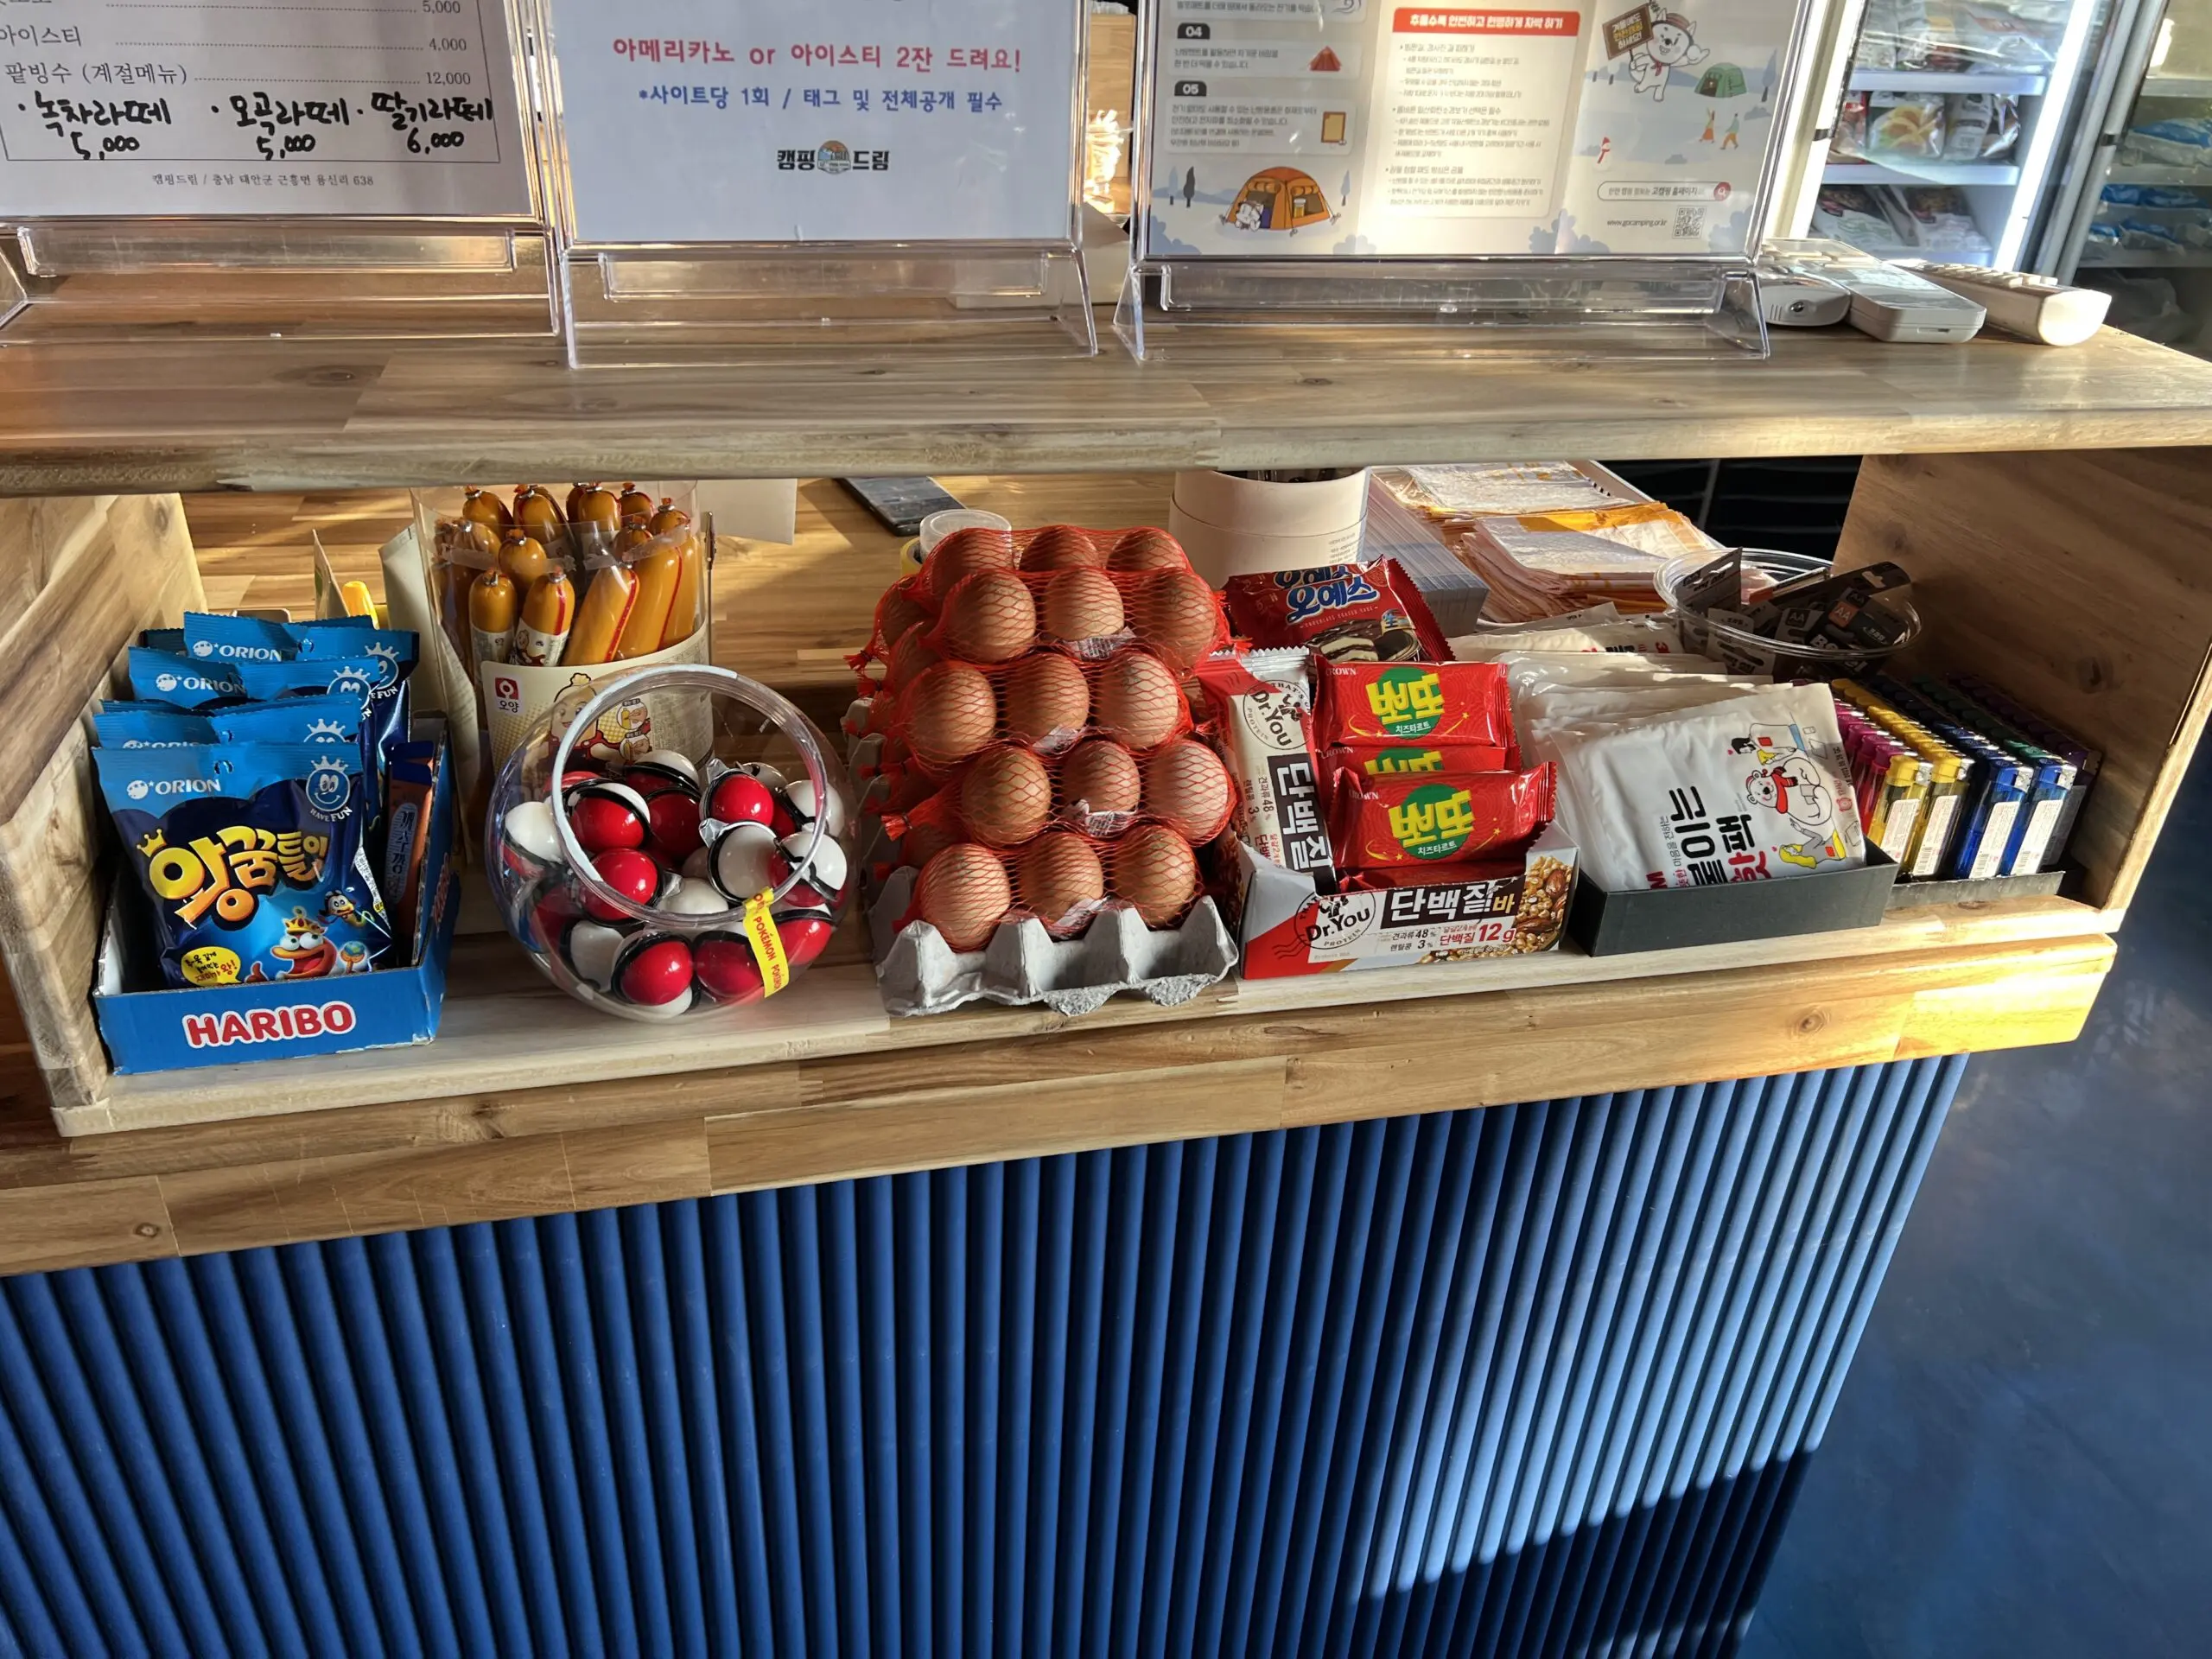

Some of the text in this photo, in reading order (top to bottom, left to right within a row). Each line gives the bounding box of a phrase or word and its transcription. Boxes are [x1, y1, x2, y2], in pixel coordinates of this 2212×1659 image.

[0, 24, 81, 47] 아이스티
[1185, 26, 1202, 37] 04
[429, 38, 467, 52] 4,000
[613, 38, 1022, 72] 아메리카노 or 아이스티 2잔 드려요!
[5, 64, 471, 86] 팥빙수 (계절메뉴) 12,000
[1182, 84, 1199, 95] 05
[741, 87, 769, 106] 1회
[804, 89, 842, 107] 태그
[853, 90, 869, 111] 및
[882, 92, 956, 111] 전체공개
[967, 92, 1003, 113] 필수
[73, 132, 465, 162] 5,000 5,000 6,000
[777, 149, 889, 171] 캠핑 드림
[213, 175, 235, 187] 충남
[238, 175, 273, 187] 태안군
[353, 175, 374, 187] 638
[1286, 575, 1380, 625] 오예스
[1789, 612, 1805, 622] AA
[1834, 607, 1851, 622] AA
[218, 645, 282, 662] ORION
[499, 700, 519, 714] 오양
[1395, 721, 1431, 734] 치즈타르트
[155, 779, 221, 795] ORION
[310, 806, 353, 823] HAVE FUN
[1275, 761, 1324, 868] 단백질
[1659, 816, 1675, 842] 전하는
[1417, 841, 1458, 856] 치즈타르트
[1666, 841, 1683, 868] 마음을
[1323, 929, 1362, 947] PROTEIN
[1392, 931, 1414, 941] 견과류
[1440, 933, 1476, 947] 단백질
[184, 1002, 356, 1049] HARIBO
